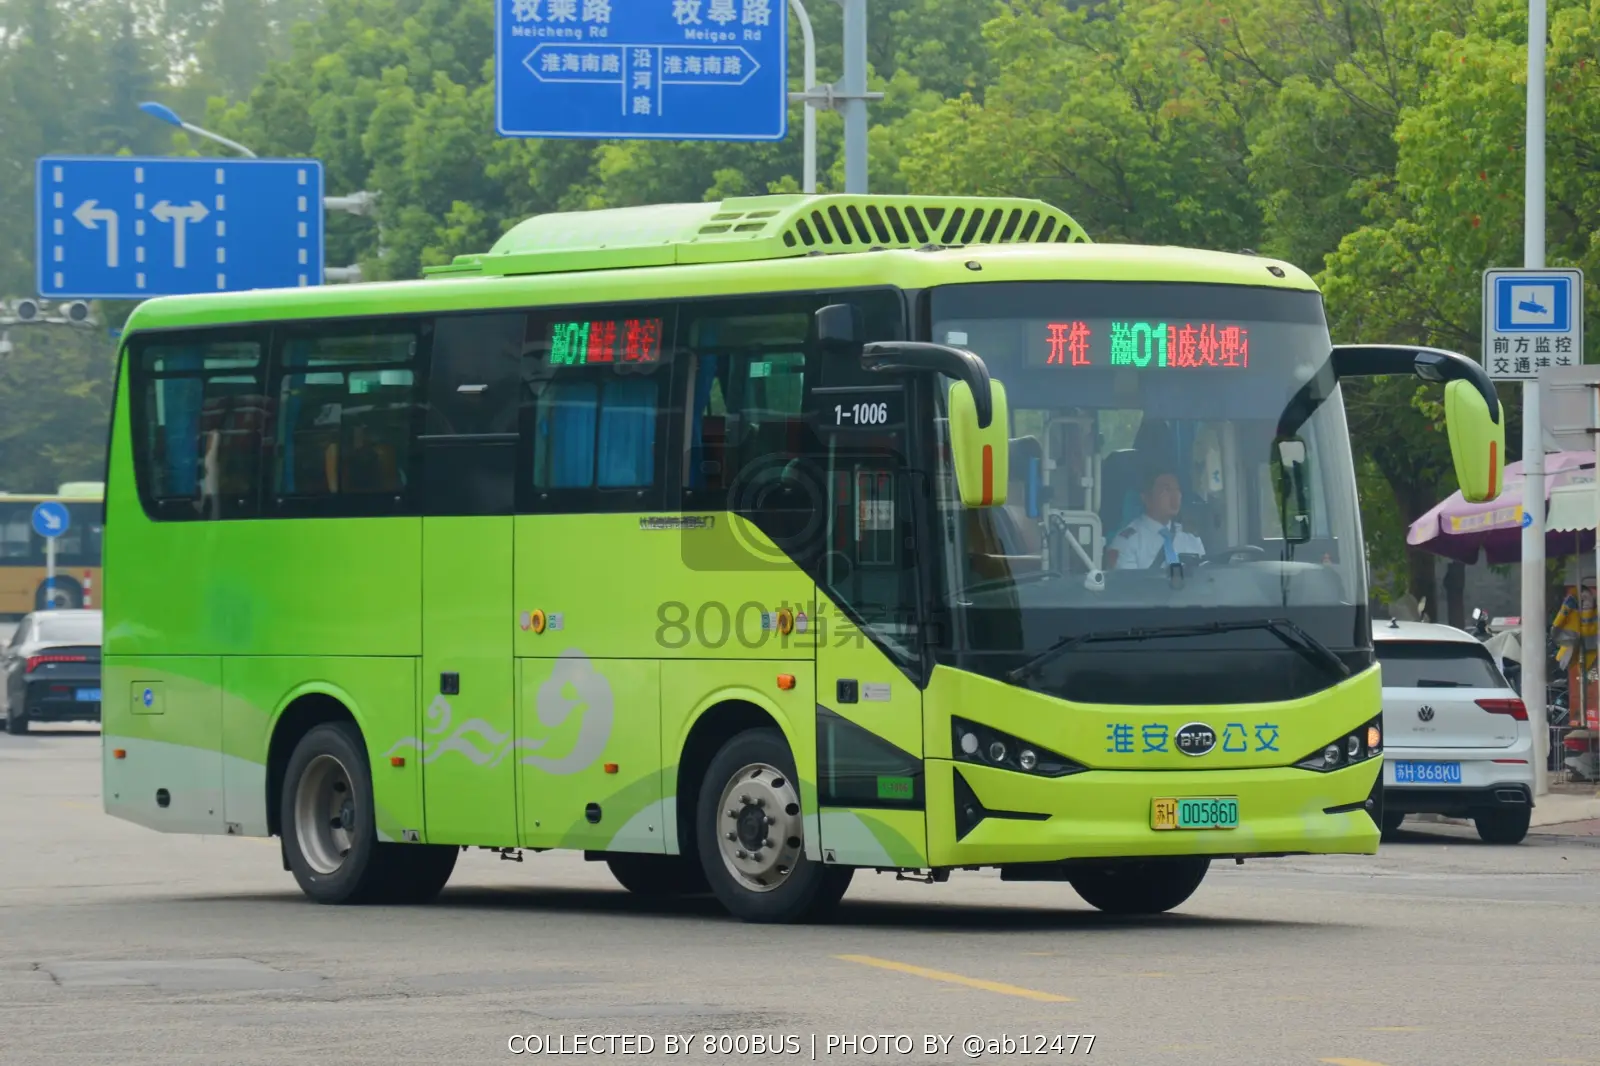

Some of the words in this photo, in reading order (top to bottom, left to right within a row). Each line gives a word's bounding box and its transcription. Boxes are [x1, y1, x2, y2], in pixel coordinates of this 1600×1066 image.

[511, 25, 583, 40] Meicheng
[589, 25, 608, 38] Rd
[684, 28, 736, 43] Meigao
[743, 29, 762, 41] Rd
[541, 53, 620, 73] 淮海南路
[664, 56, 743, 75] 淮海南路
[633, 48, 652, 115] 沿河路
[1046, 321, 1091, 366] 开往
[1493, 336, 1572, 354] 前方监控
[834, 402, 887, 426] 1-1006
[1106, 723, 1168, 753] 淮安
[1180, 732, 1213, 747] BYD
[1222, 723, 1279, 752] 公交
